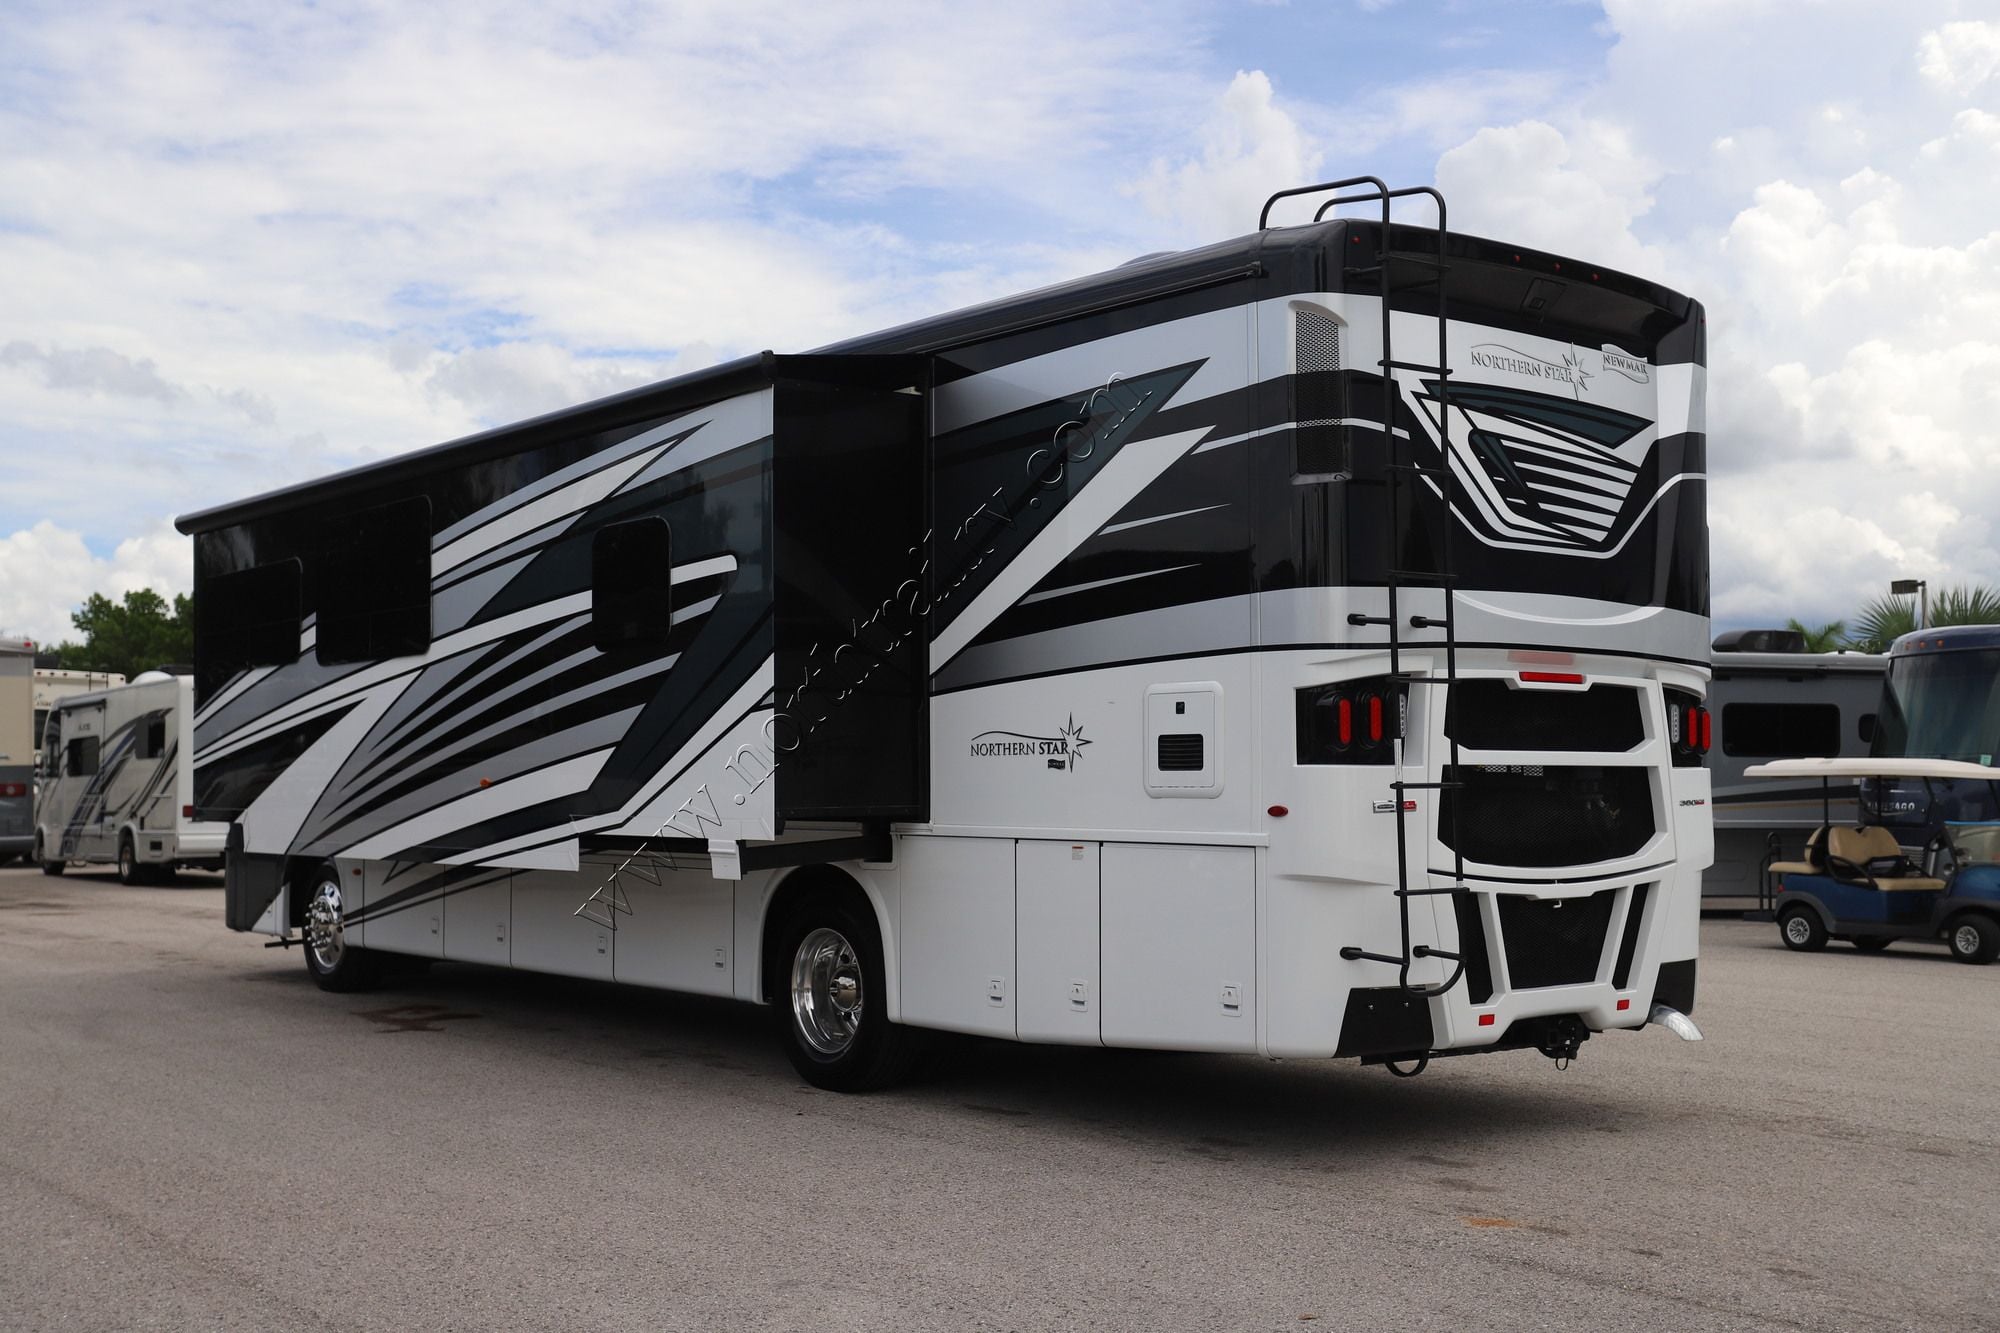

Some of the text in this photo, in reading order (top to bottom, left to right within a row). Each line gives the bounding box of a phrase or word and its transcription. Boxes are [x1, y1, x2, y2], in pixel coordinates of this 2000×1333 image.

[1470, 351, 1576, 384] NORTHERN STAR
[1602, 353, 1649, 375] NEWMAR
[970, 741, 1070, 757] NORTHERN STAR
